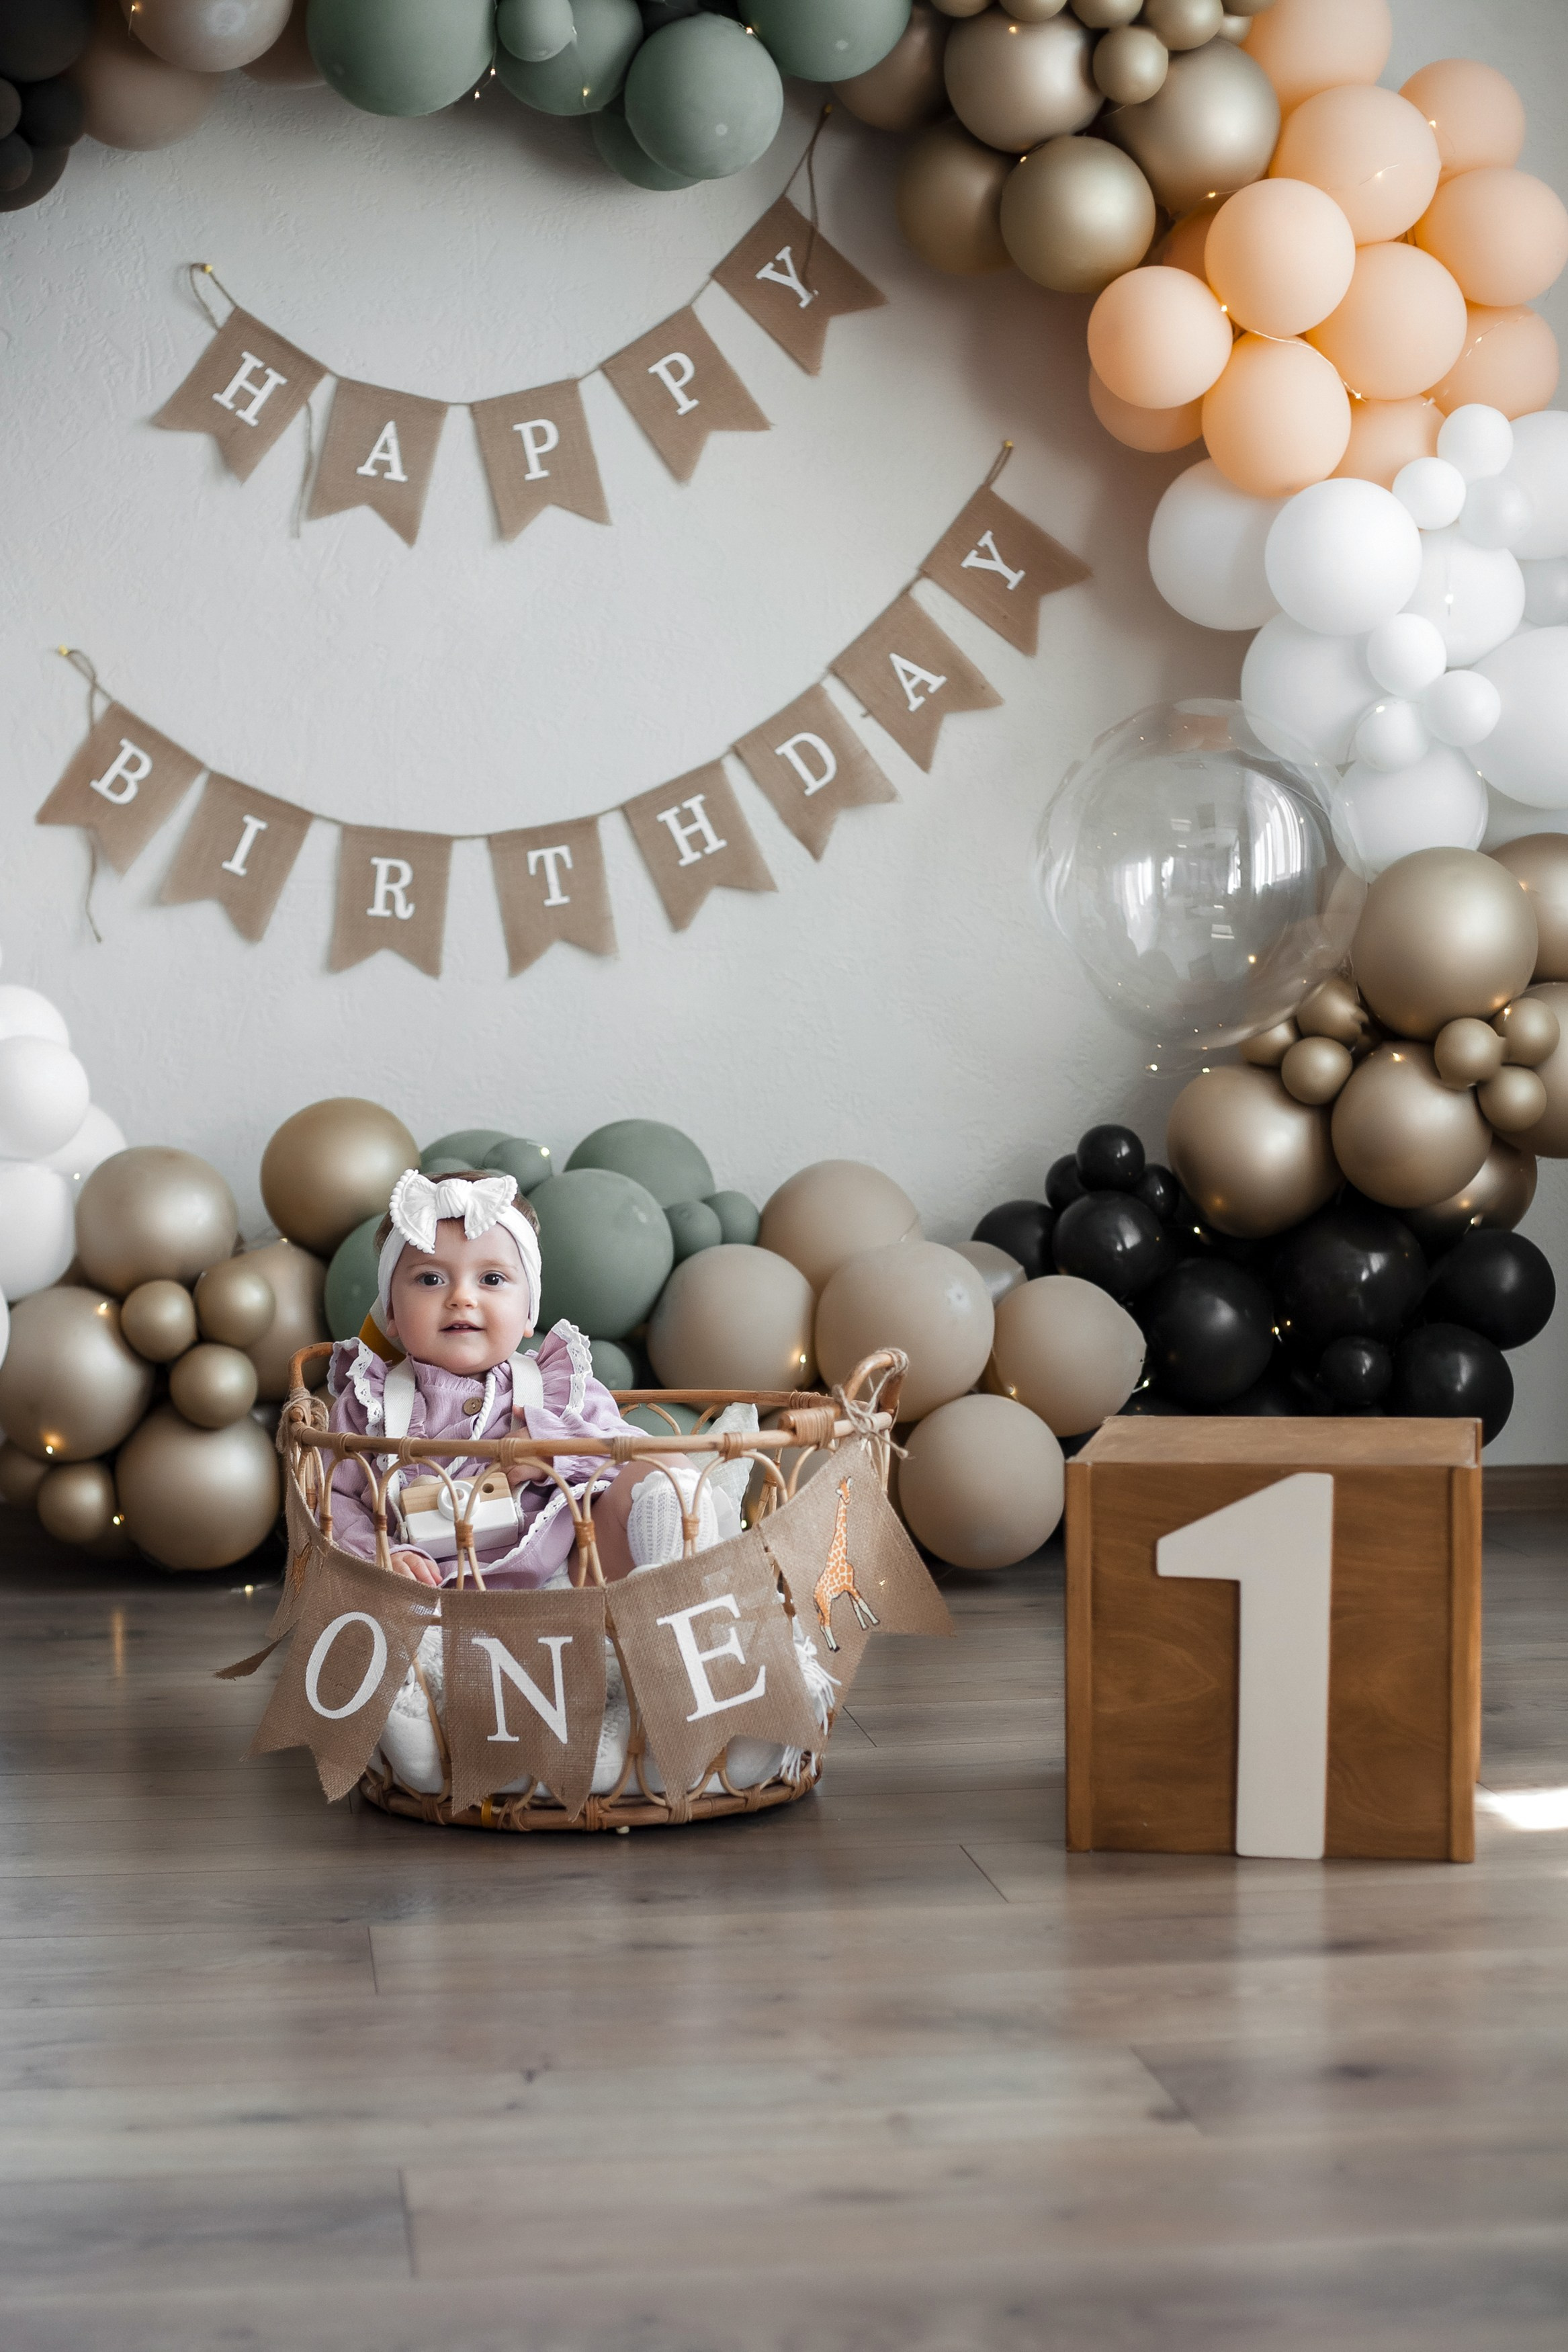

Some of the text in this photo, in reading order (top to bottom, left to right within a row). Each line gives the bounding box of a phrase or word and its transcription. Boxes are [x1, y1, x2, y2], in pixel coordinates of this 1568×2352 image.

[211, 246, 818, 482] HAPPY
[91, 530, 1026, 921] BIRTHDAY
[305, 1593, 767, 1745] ONE
[1156, 1471, 1334, 1859] 1
